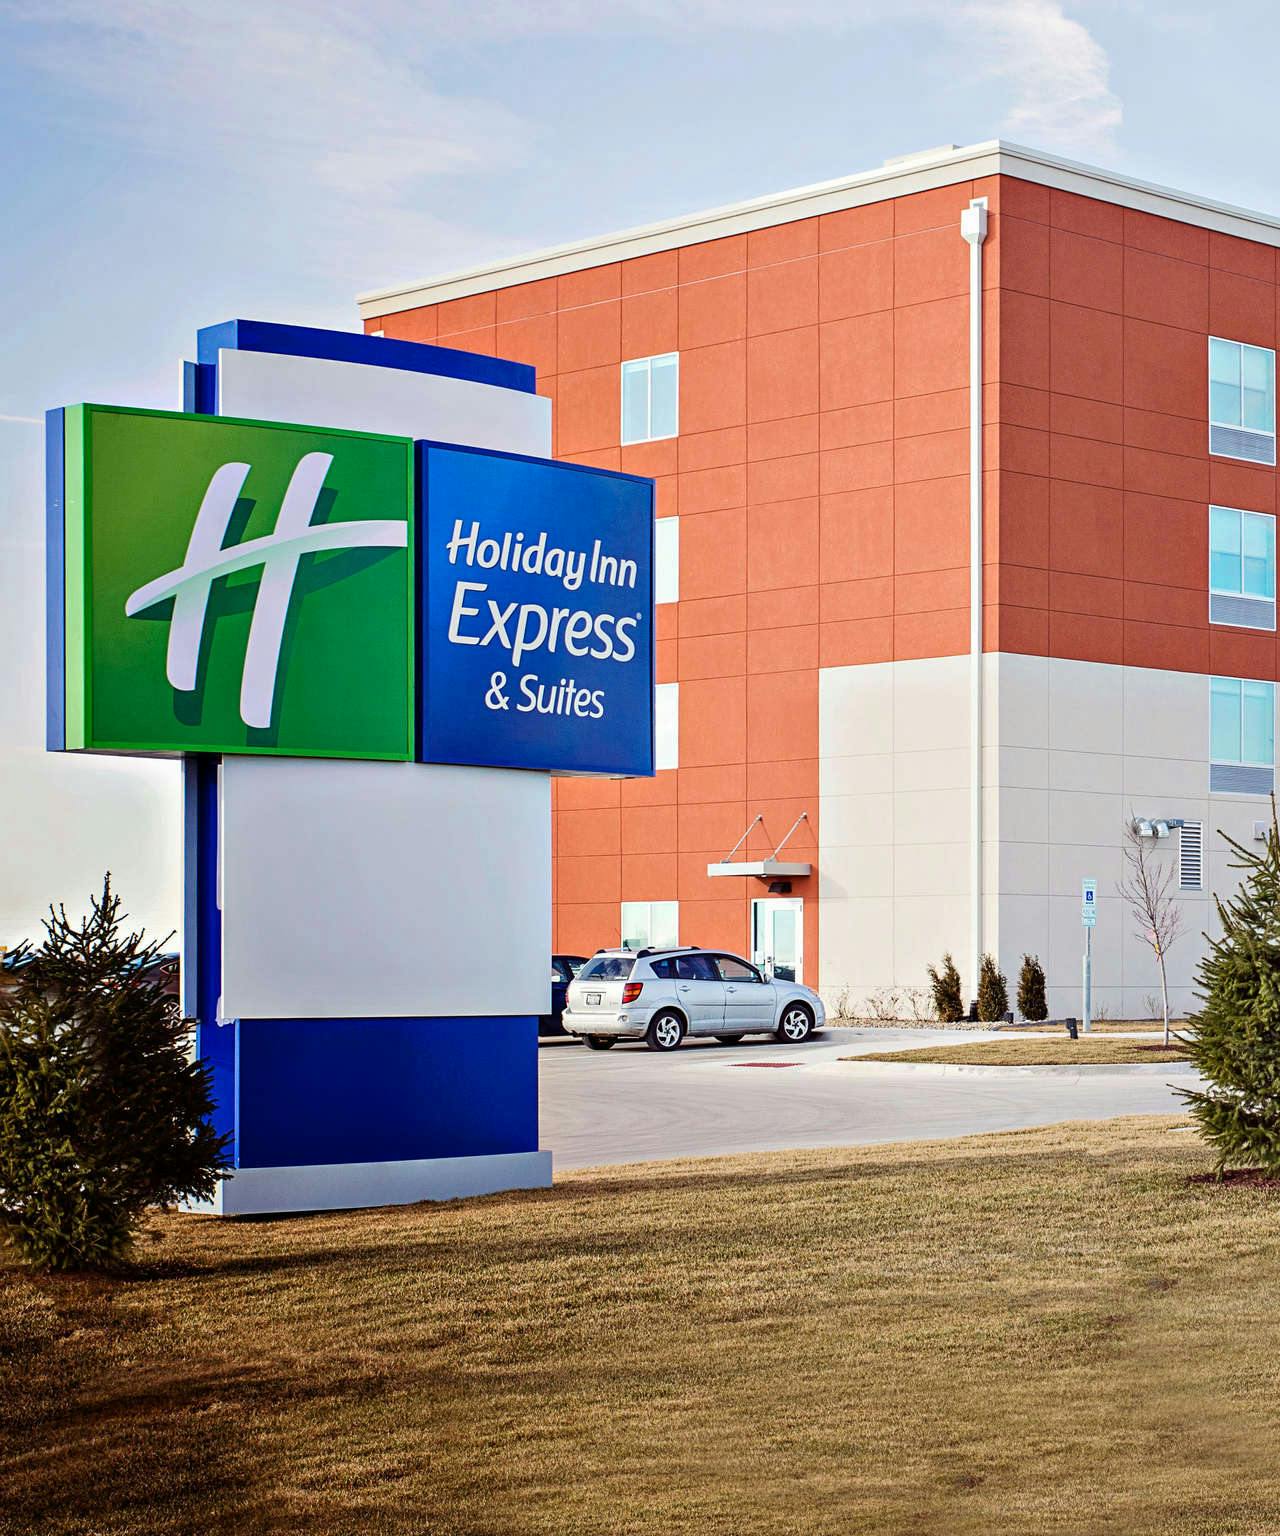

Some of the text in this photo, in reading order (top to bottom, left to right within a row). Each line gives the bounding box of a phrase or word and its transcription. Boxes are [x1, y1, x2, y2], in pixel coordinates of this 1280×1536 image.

[446, 519, 638, 591] Holiday Inn
[447, 580, 639, 668] Express
[484, 671, 605, 719] & Suites
